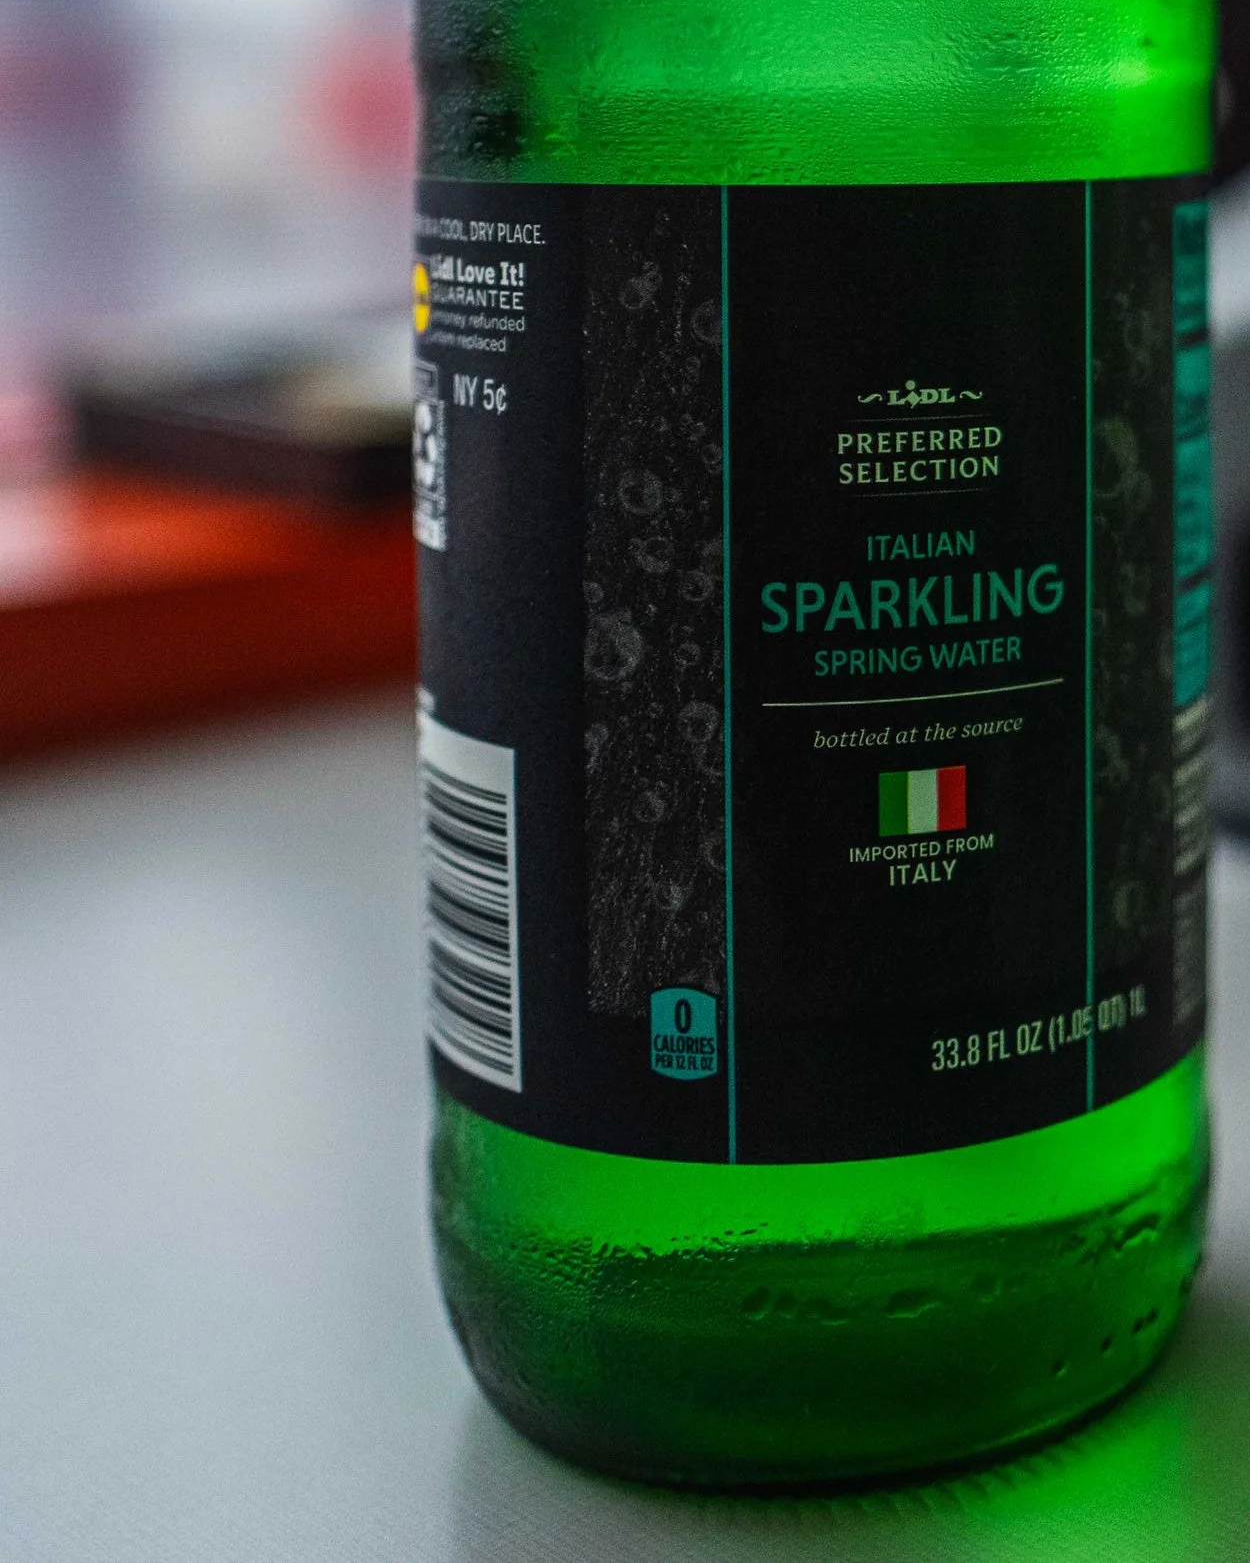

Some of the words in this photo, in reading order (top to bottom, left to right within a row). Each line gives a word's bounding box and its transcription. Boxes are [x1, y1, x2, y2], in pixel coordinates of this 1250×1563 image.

[469, 220, 494, 242] DRY
[498, 222, 546, 245] PLACE.
[457, 257, 496, 285] Love
[500, 261, 524, 287] It!
[469, 312, 525, 332] refunded
[457, 333, 507, 352] replaced
[453, 373, 479, 407] NY
[483, 378, 507, 415] 5¢
[837, 426, 1002, 455] PREFERRED
[839, 455, 999, 485] SELECTION
[867, 530, 975, 561] ITALIAN
[761, 563, 1065, 633] SPARKLING
[814, 645, 922, 677] SPRING
[929, 636, 1021, 669] WATER
[813, 727, 890, 749] bottled
[895, 726, 918, 744] at
[924, 722, 956, 742] the
[961, 716, 1024, 738] source
[849, 841, 941, 863] IMPORTED
[946, 833, 995, 854] FROM
[889, 859, 957, 886] ITALY
[674, 998, 692, 1034] 0
[653, 1034, 716, 1055] CALORIES
[931, 1034, 980, 1071] 33.8
[987, 1029, 1011, 1062] FL
[1016, 1020, 1043, 1055] OZ
[655, 1053, 673, 1069] PER
[700, 1056, 713, 1071] OZ
